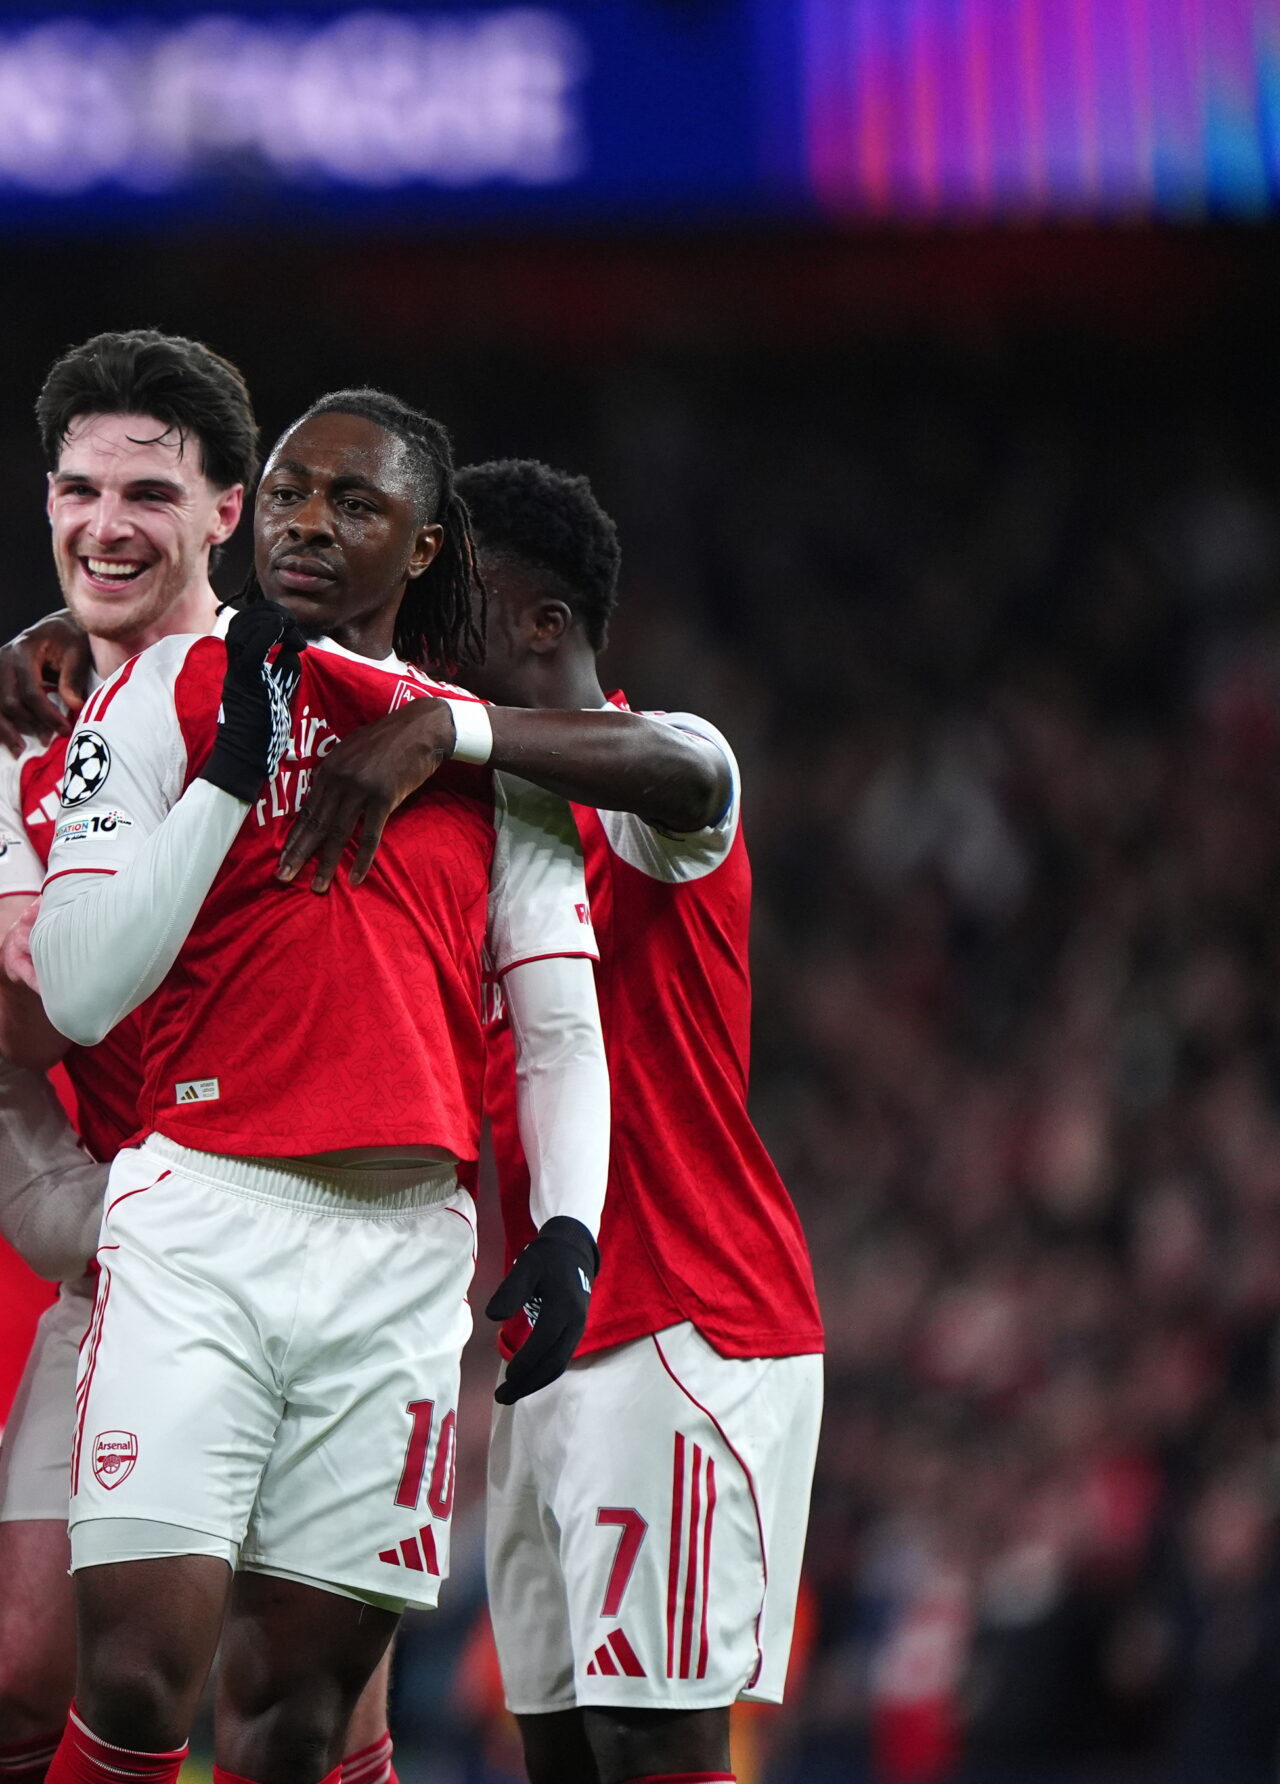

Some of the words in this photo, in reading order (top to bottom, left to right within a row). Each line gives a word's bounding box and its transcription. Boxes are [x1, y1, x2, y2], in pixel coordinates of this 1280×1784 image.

[97, 1440, 131, 1450] Arsenal
[393, 1398, 456, 1522] 10
[595, 1506, 649, 1618] 7
